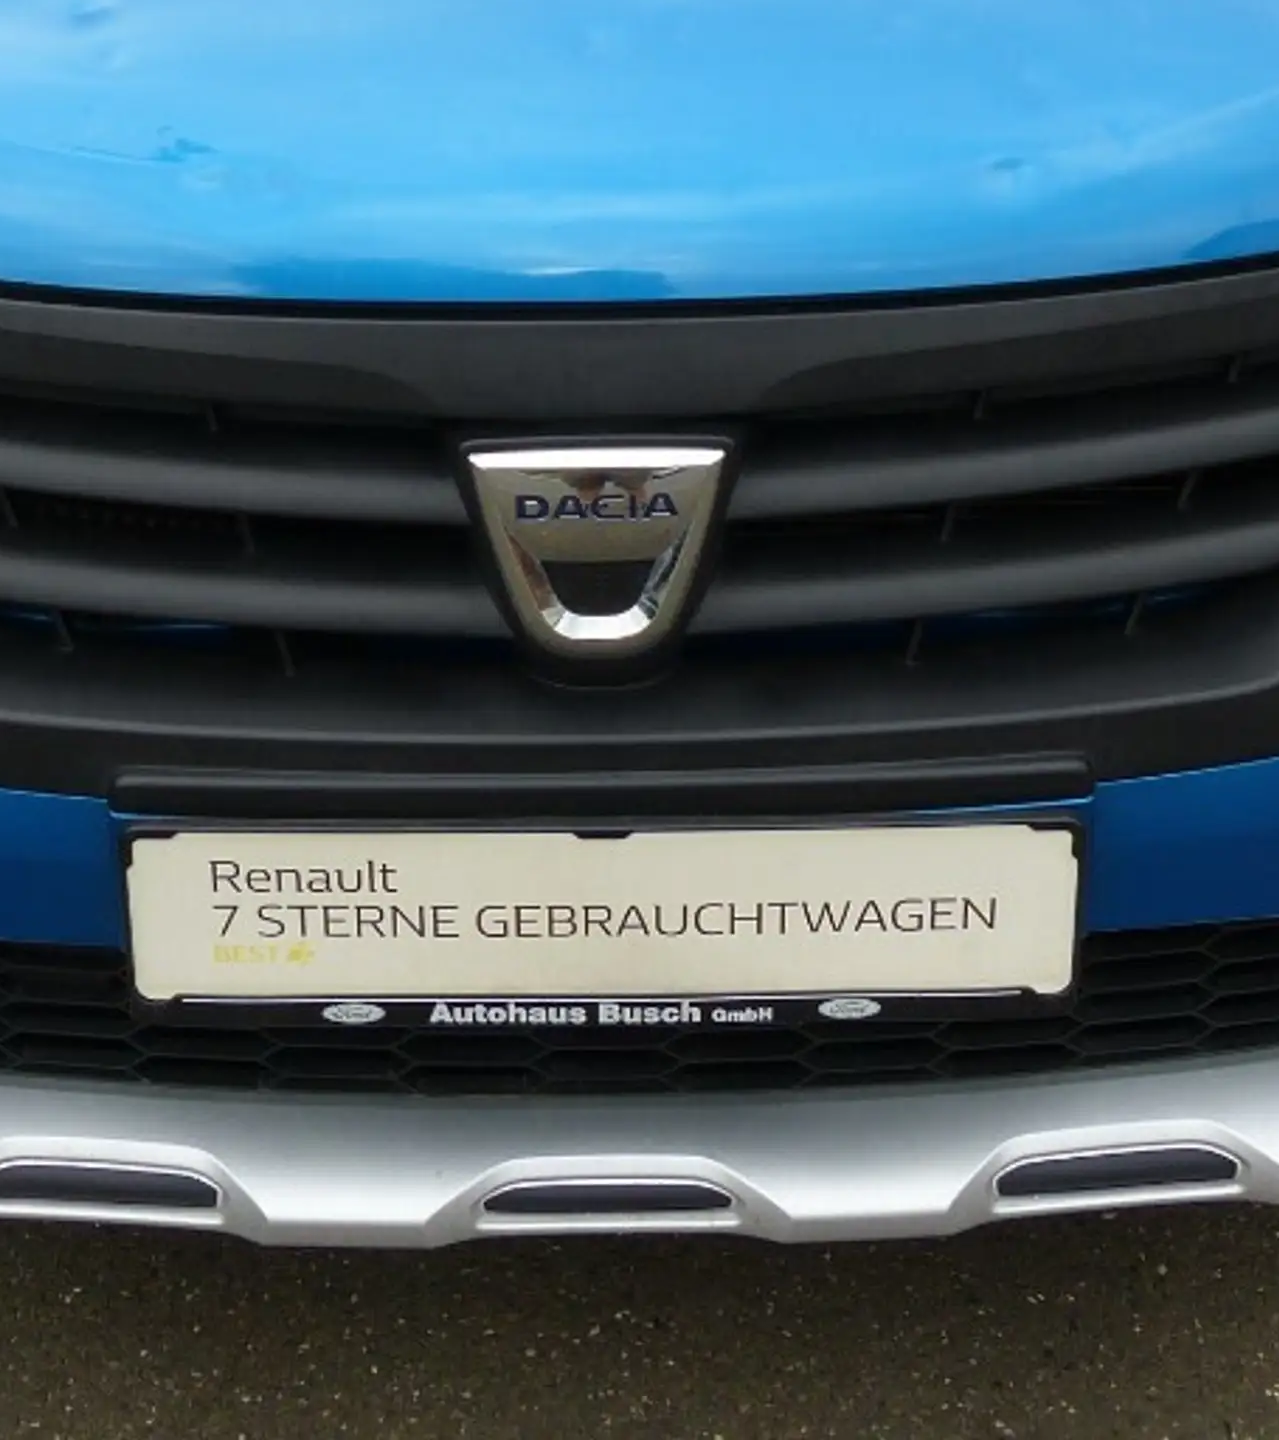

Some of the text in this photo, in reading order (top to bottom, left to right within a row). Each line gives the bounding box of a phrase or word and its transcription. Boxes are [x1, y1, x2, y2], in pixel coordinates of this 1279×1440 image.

[515, 492, 679, 519] DACIA
[209, 859, 398, 893] Renault
[213, 897, 997, 938] 7 STERNE GEBRAUCHTWAGEN
[429, 1002, 587, 1025] Autohaus
[598, 1001, 701, 1024] Busch
